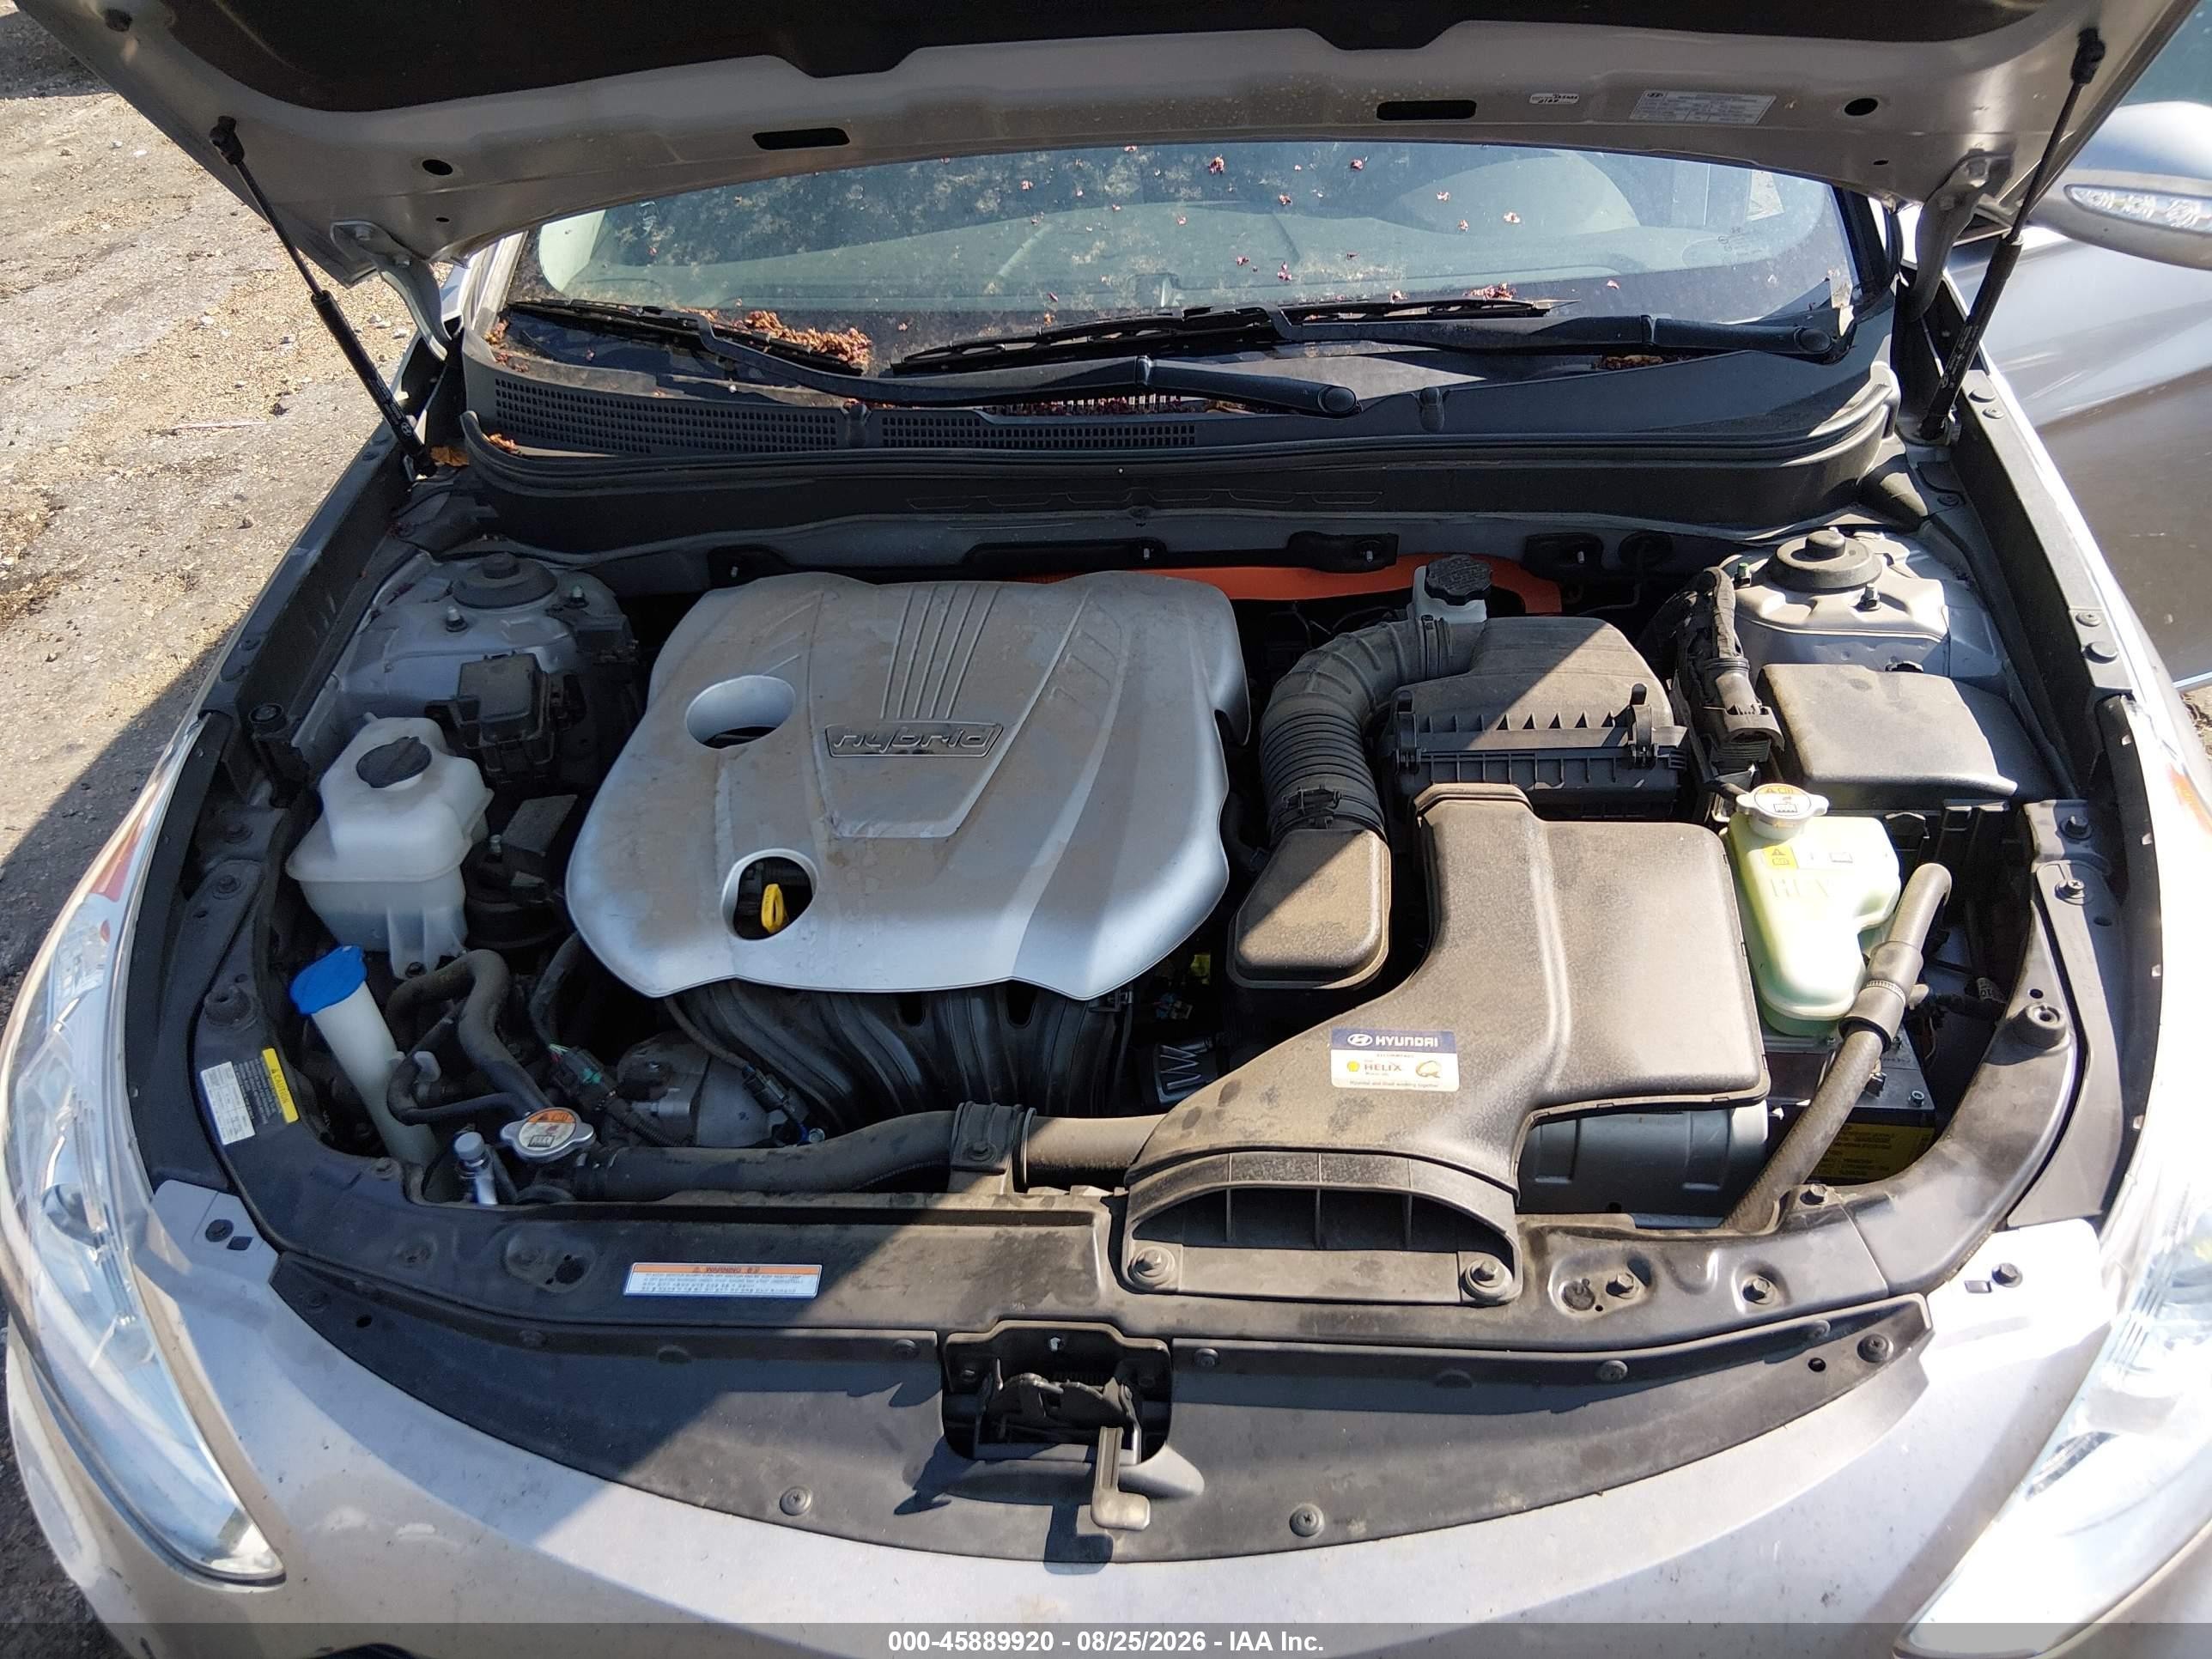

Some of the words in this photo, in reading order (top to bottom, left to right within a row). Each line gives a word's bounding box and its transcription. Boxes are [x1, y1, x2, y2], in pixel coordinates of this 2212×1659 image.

[1375, 1036, 1438, 1048] HYUNDAI
[1364, 1061, 1402, 1072] HELIX
[274, 1074, 289, 1104] CAUTION
